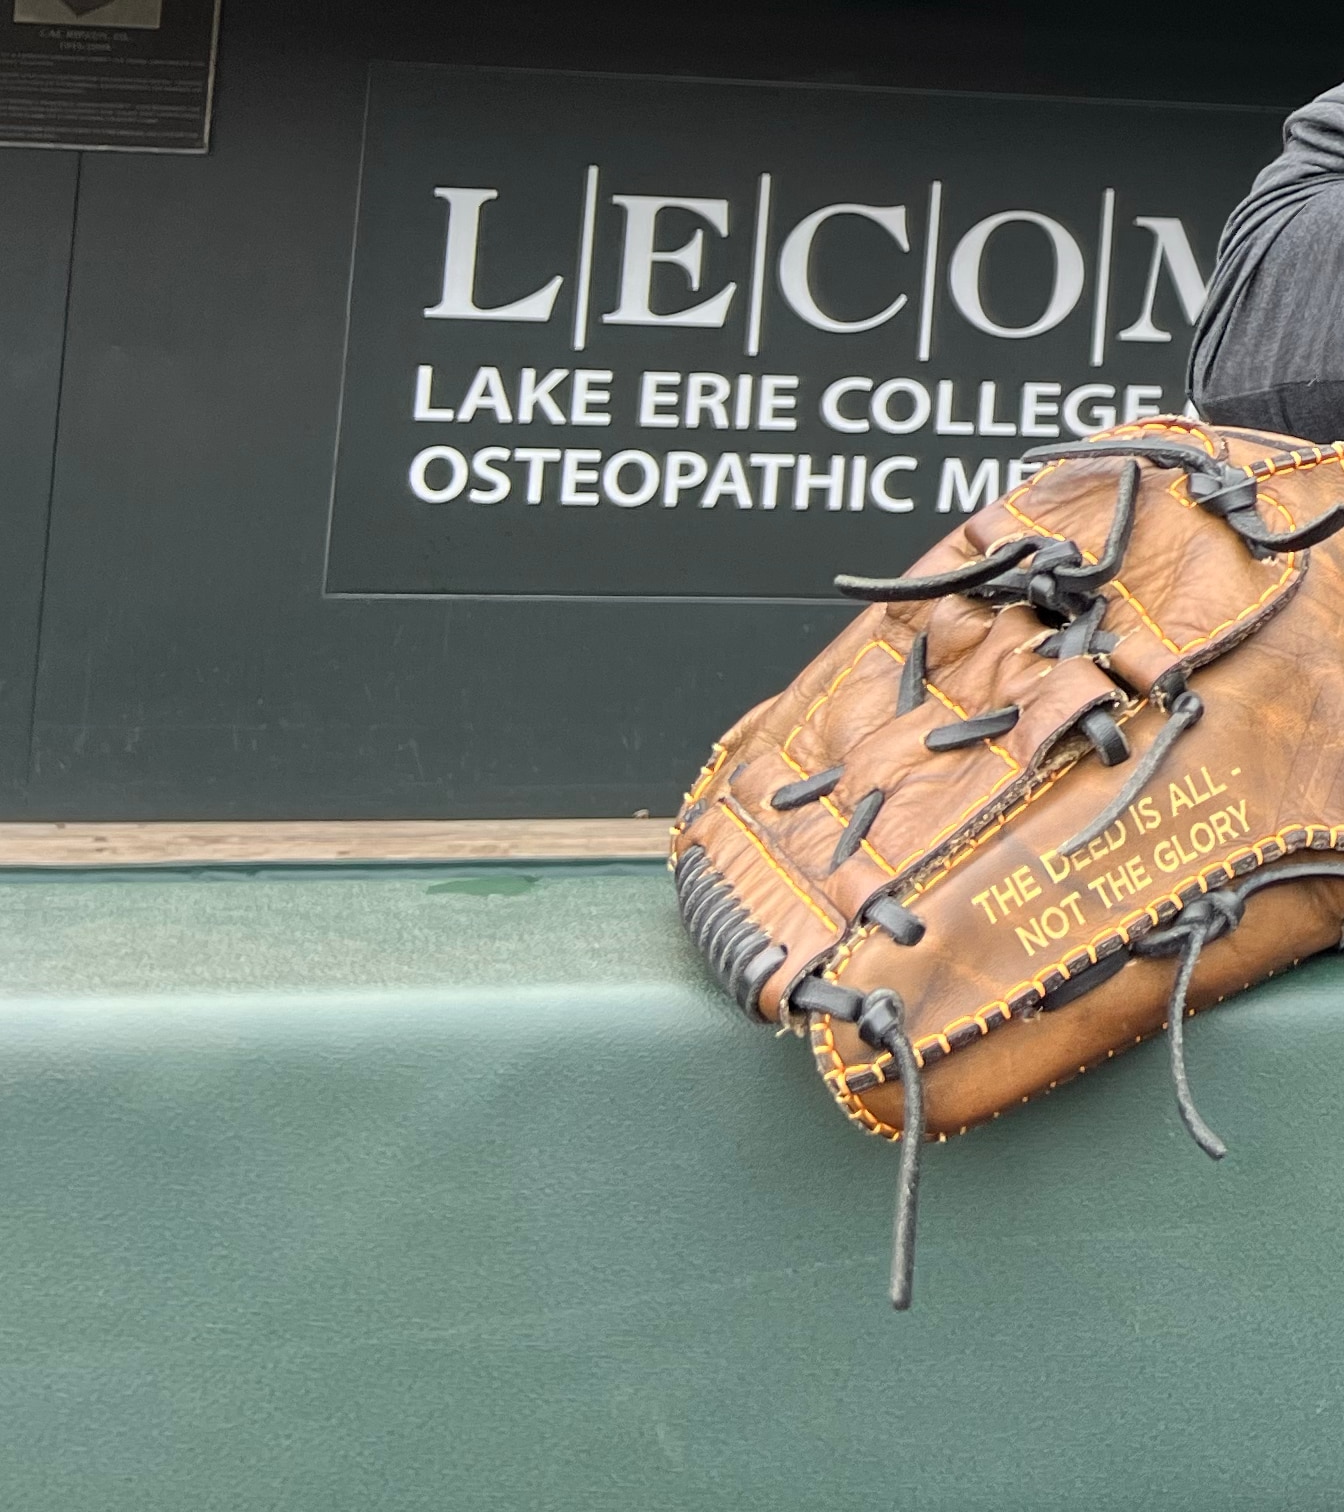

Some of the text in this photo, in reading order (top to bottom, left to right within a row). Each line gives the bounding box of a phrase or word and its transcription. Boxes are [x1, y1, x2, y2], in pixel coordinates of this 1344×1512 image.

[414, 364, 1163, 438] LAKE ERIE COLLEGE
[409, 445, 919, 514] OSTEOPATHIC
[971, 865, 1042, 925] THE
[1129, 796, 1162, 835] IS
[1014, 799, 1250, 956] NOT THE GLORY
